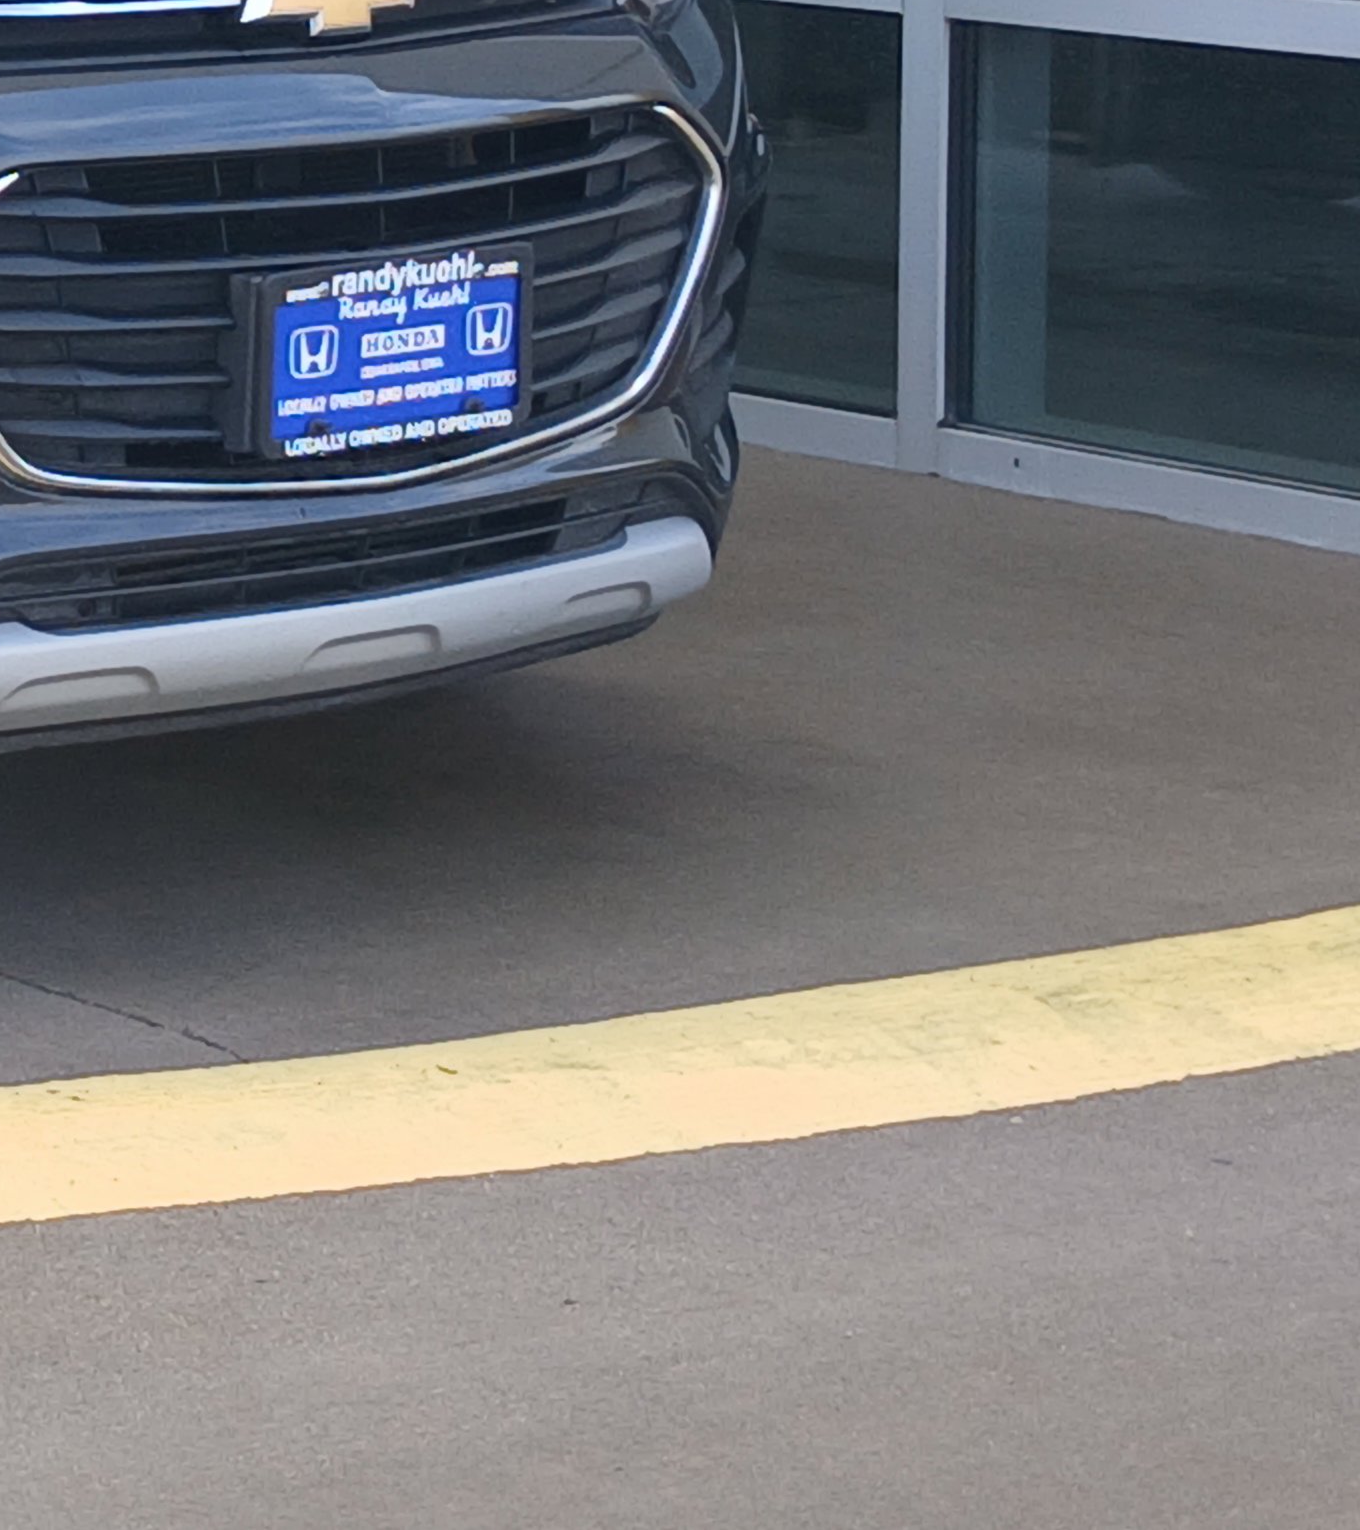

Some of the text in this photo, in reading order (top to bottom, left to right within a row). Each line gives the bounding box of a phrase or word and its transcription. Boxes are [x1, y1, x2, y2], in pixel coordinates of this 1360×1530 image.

[338, 281, 471, 324] Randy Kuehl
[366, 328, 440, 353] HONDA
